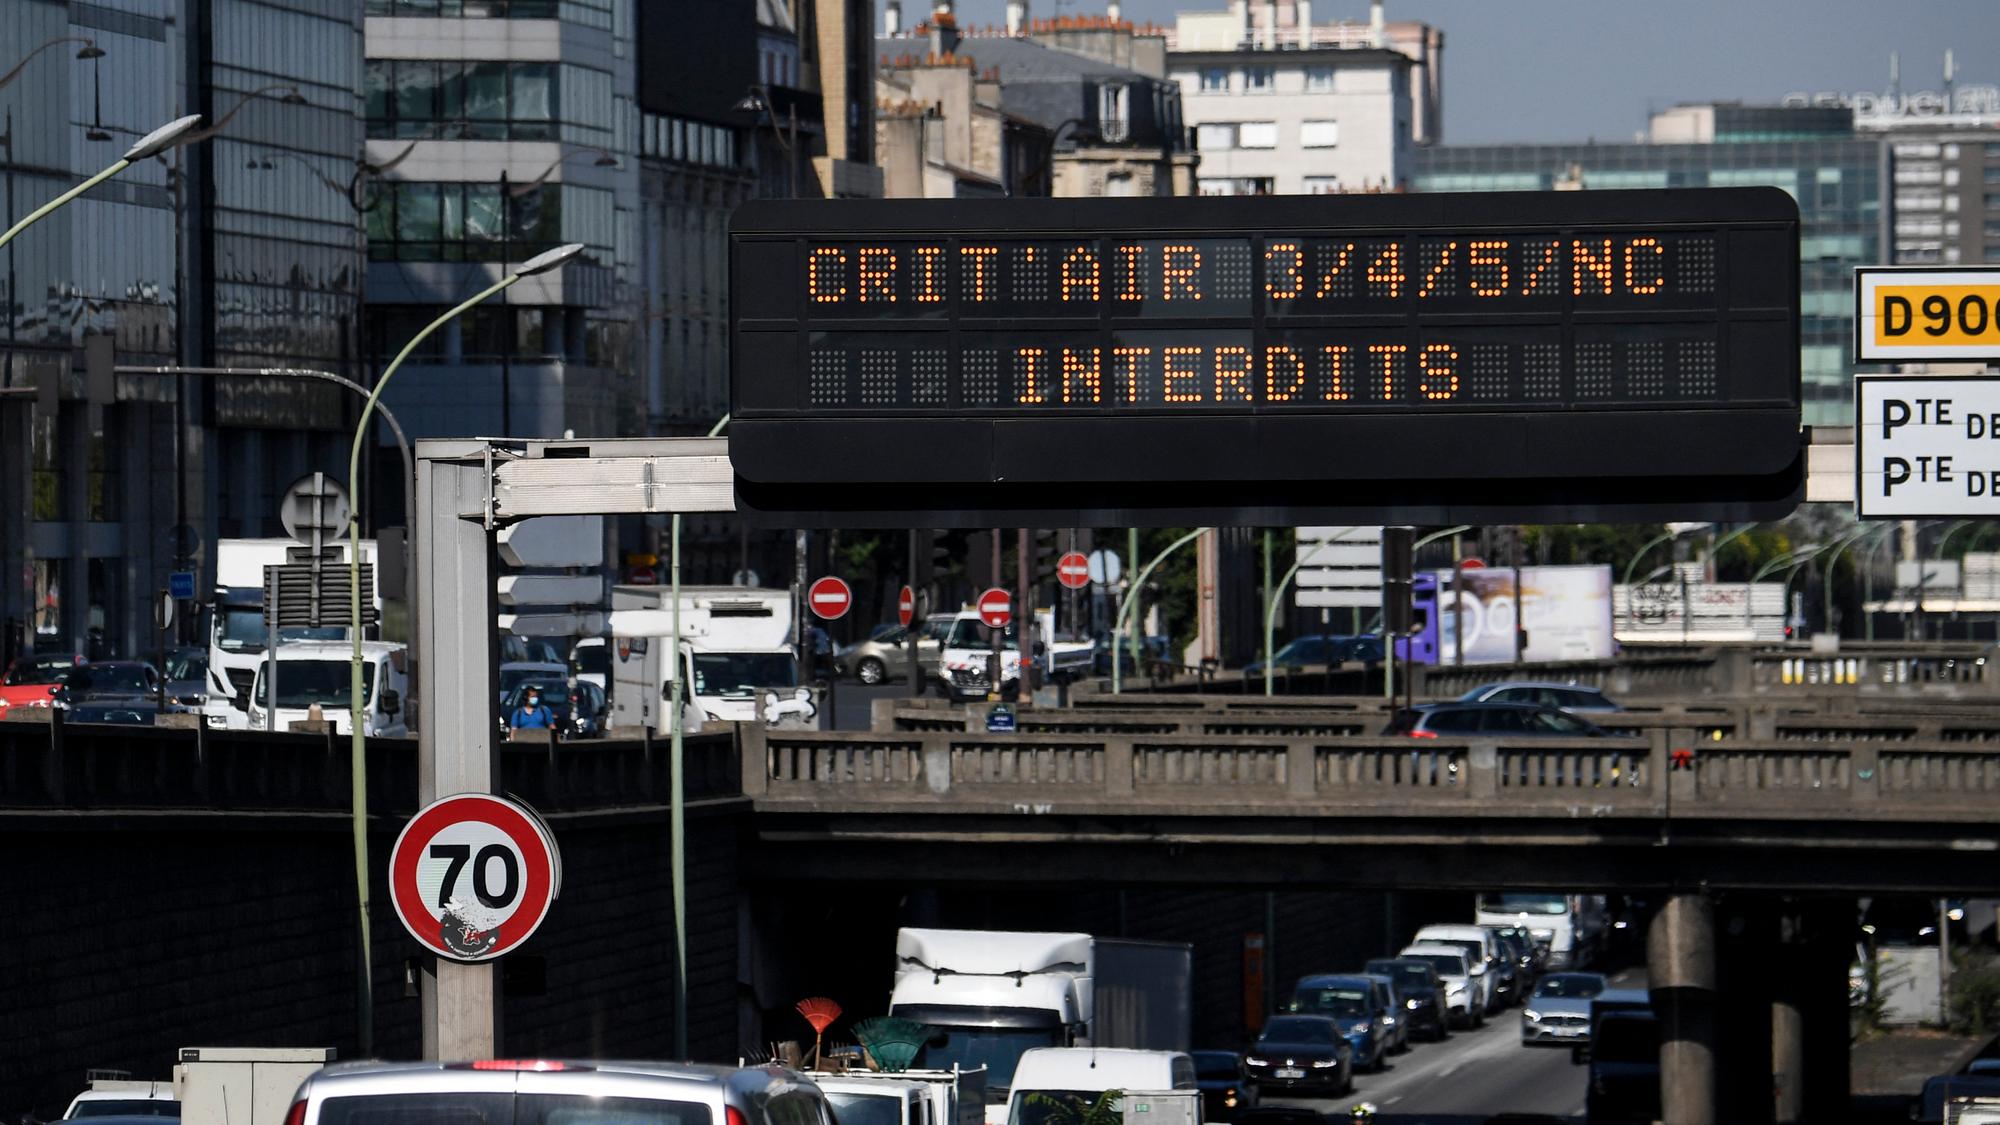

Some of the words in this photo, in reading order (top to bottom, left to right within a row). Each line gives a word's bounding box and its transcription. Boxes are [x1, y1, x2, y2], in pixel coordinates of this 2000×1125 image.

[809, 246, 1202, 303] CRIT'AIR
[1265, 238, 1664, 299] 3/4/5/NC
[1883, 295, 2000, 337] D90
[1020, 344, 1459, 403] INTERDITS
[1882, 399, 1953, 439] PTE
[1883, 456, 1953, 496] PTE
[429, 843, 520, 910] 70
